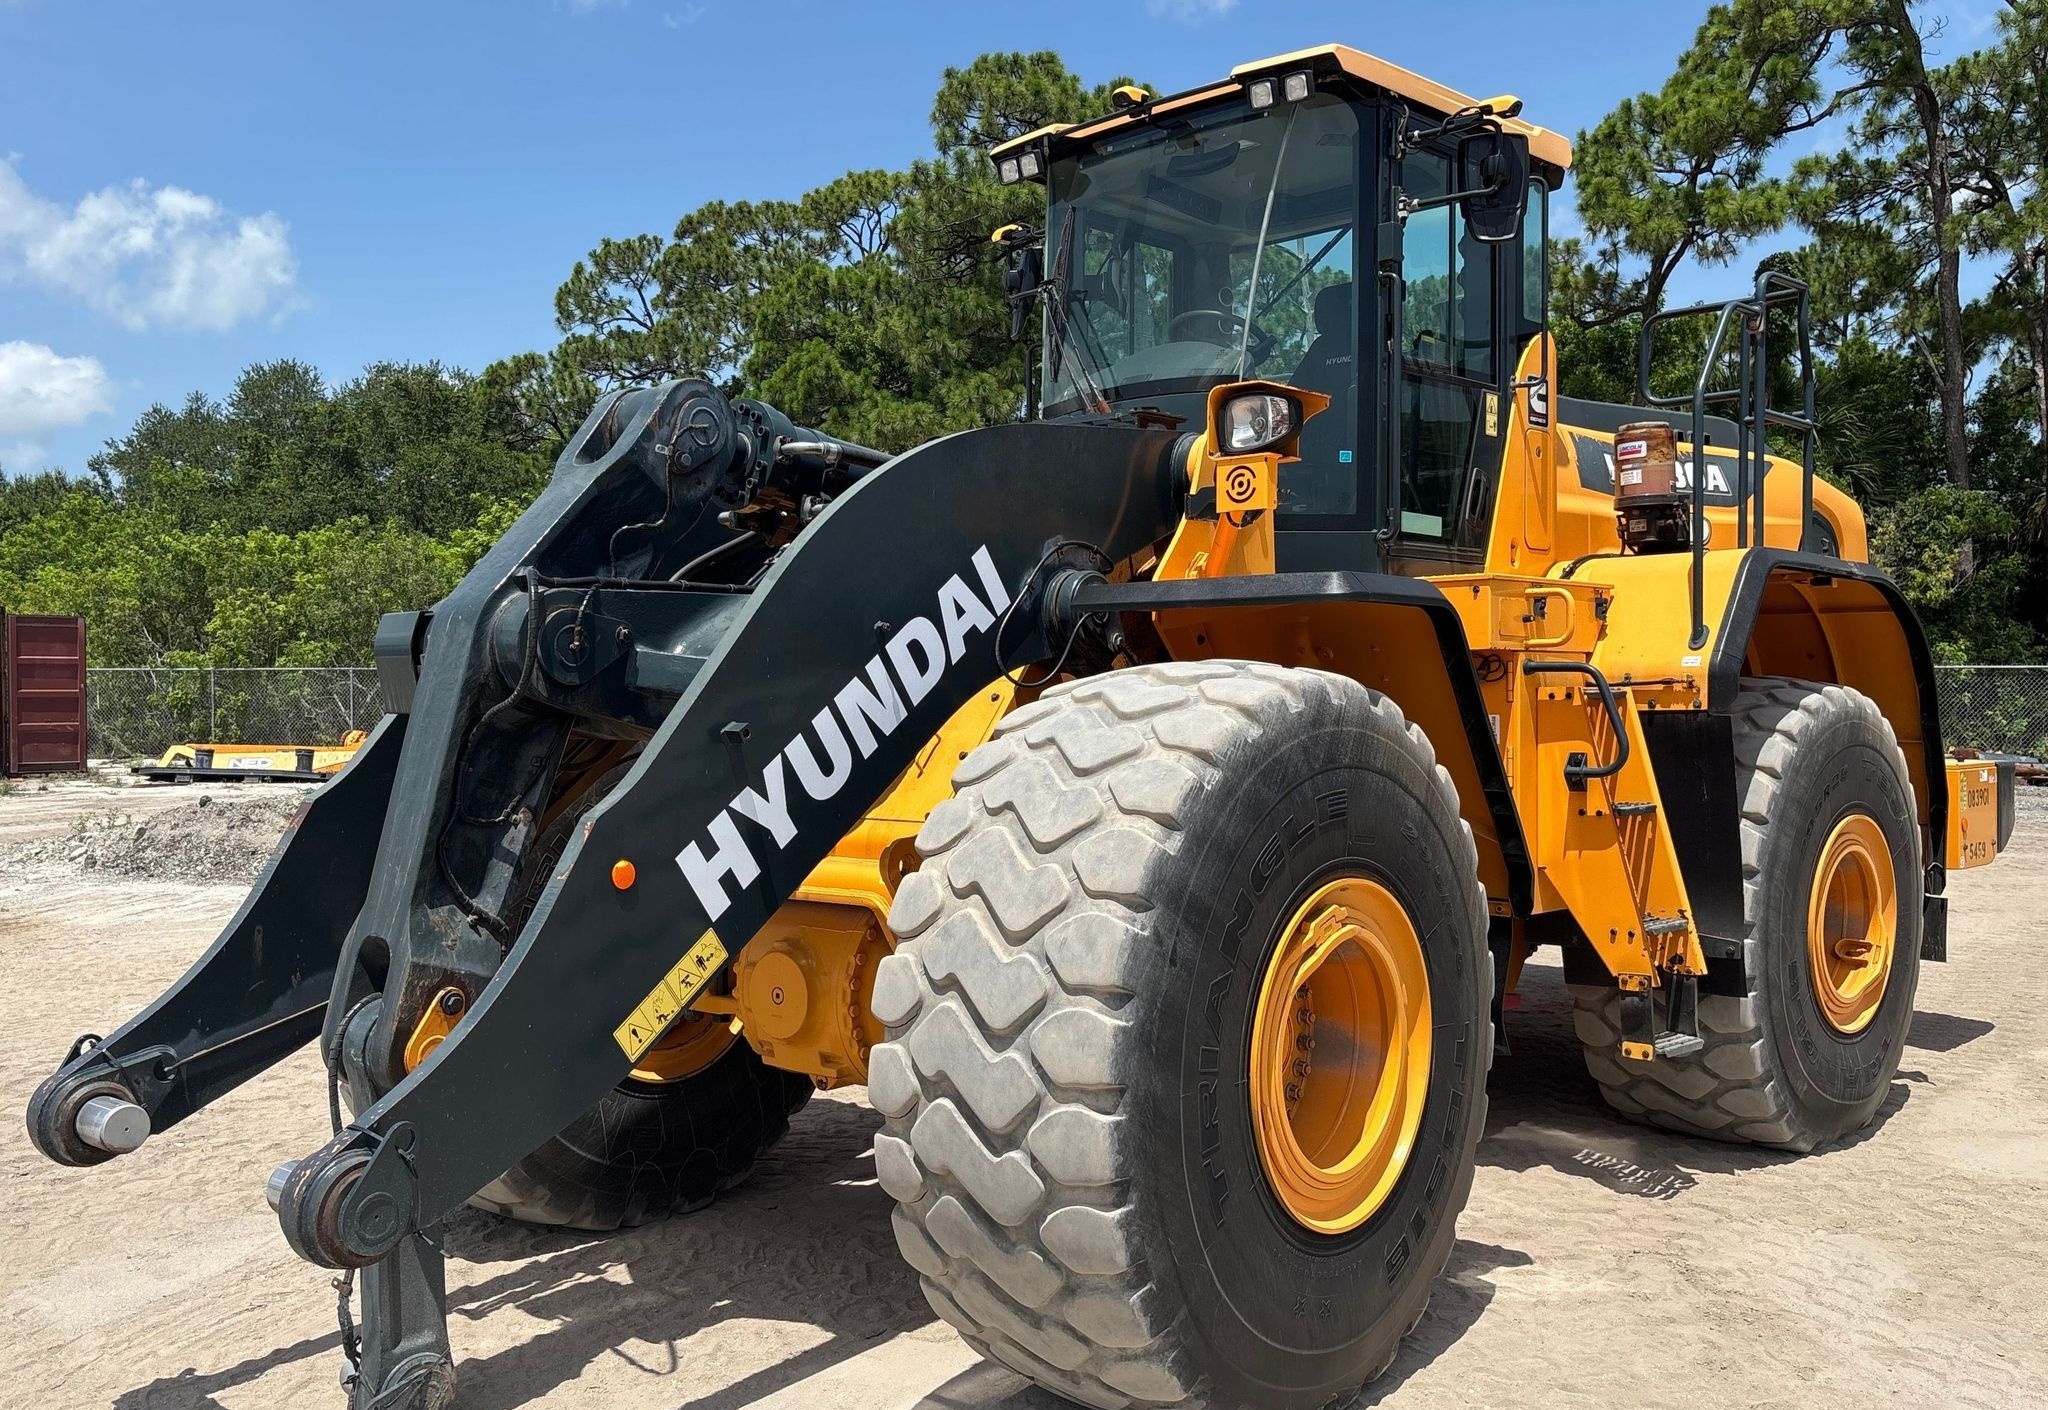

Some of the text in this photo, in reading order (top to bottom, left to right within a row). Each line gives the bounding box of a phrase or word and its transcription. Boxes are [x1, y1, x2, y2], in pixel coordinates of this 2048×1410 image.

[675, 544, 1012, 923] HYUNDAI
[1969, 841, 1987, 860] 5459
[1198, 788, 1350, 1228] TRIANGLE
